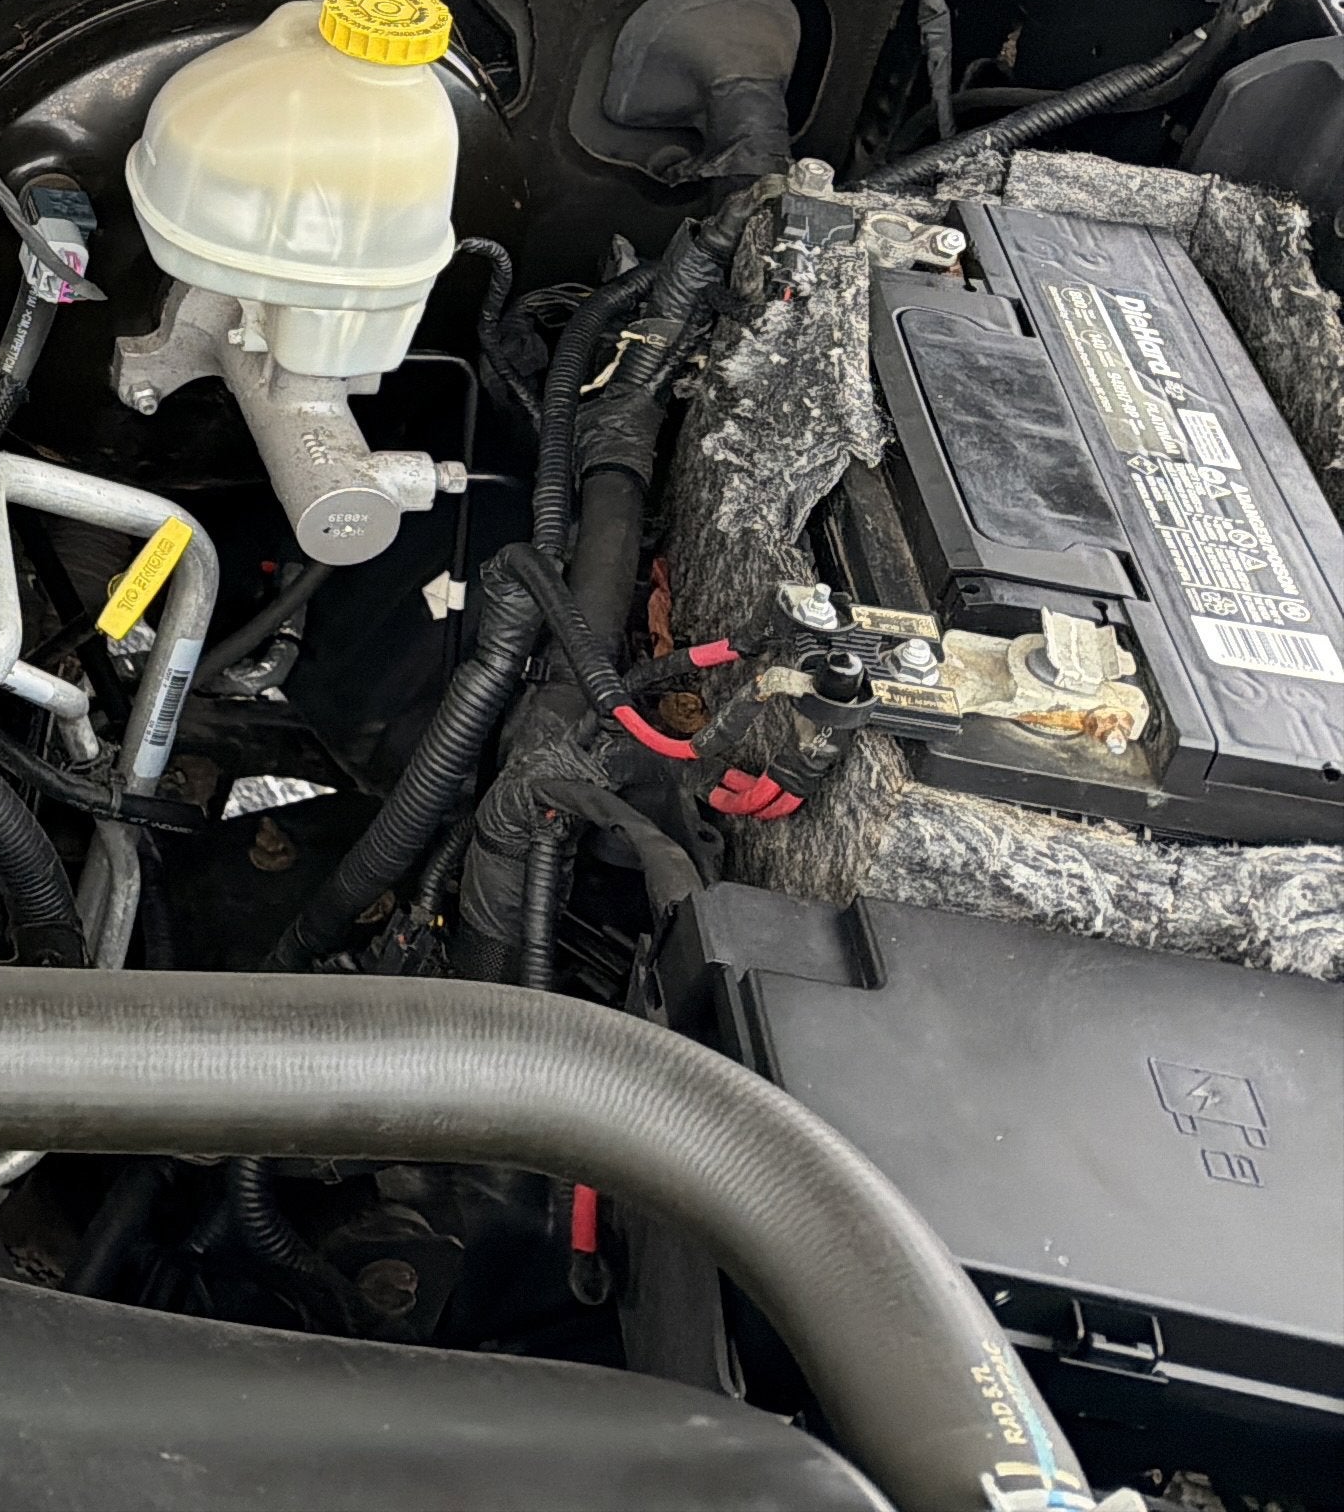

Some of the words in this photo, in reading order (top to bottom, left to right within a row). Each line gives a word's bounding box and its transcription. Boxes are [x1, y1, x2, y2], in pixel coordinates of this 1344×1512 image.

[1115, 294, 1181, 378] DieHard
[1143, 401, 1180, 455] PLATINUM
[132, 537, 176, 592] ENGINE
[117, 586, 139, 612] OIL
